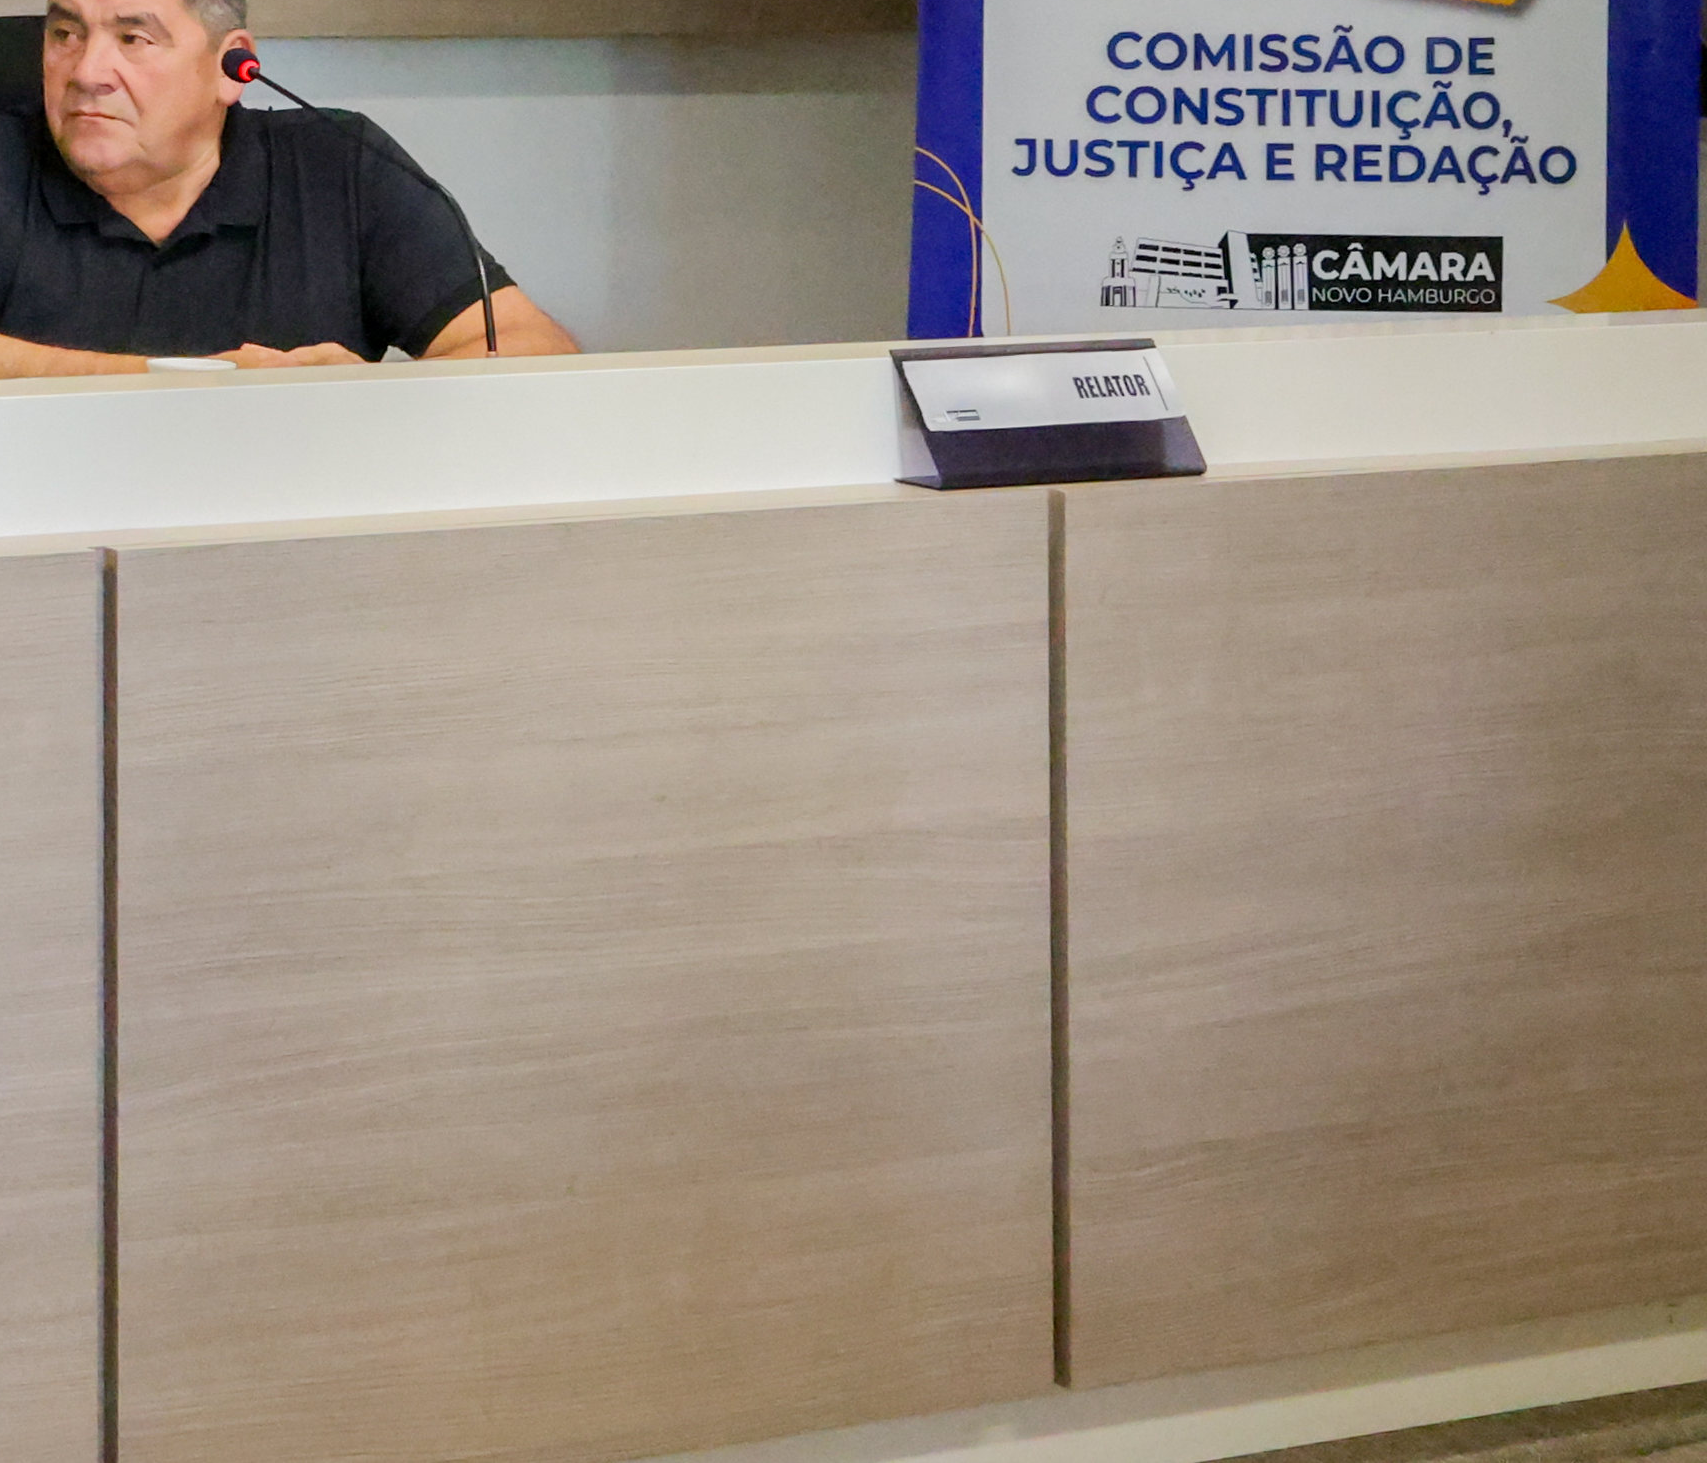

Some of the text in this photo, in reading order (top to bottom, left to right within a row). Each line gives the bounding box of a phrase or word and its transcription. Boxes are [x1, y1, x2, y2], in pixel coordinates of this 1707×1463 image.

[1106, 24, 1495, 75] COMISSÃO DE
[1086, 80, 1513, 140] CONSTITUIÇÃO,
[1012, 135, 1577, 195] JUSTIÇA E REDAÇÃO
[1312, 242, 1496, 282] CÂMARA
[1312, 287, 1496, 305] NOVO HAMBURGO
[1072, 374, 1150, 399] RELATOR
